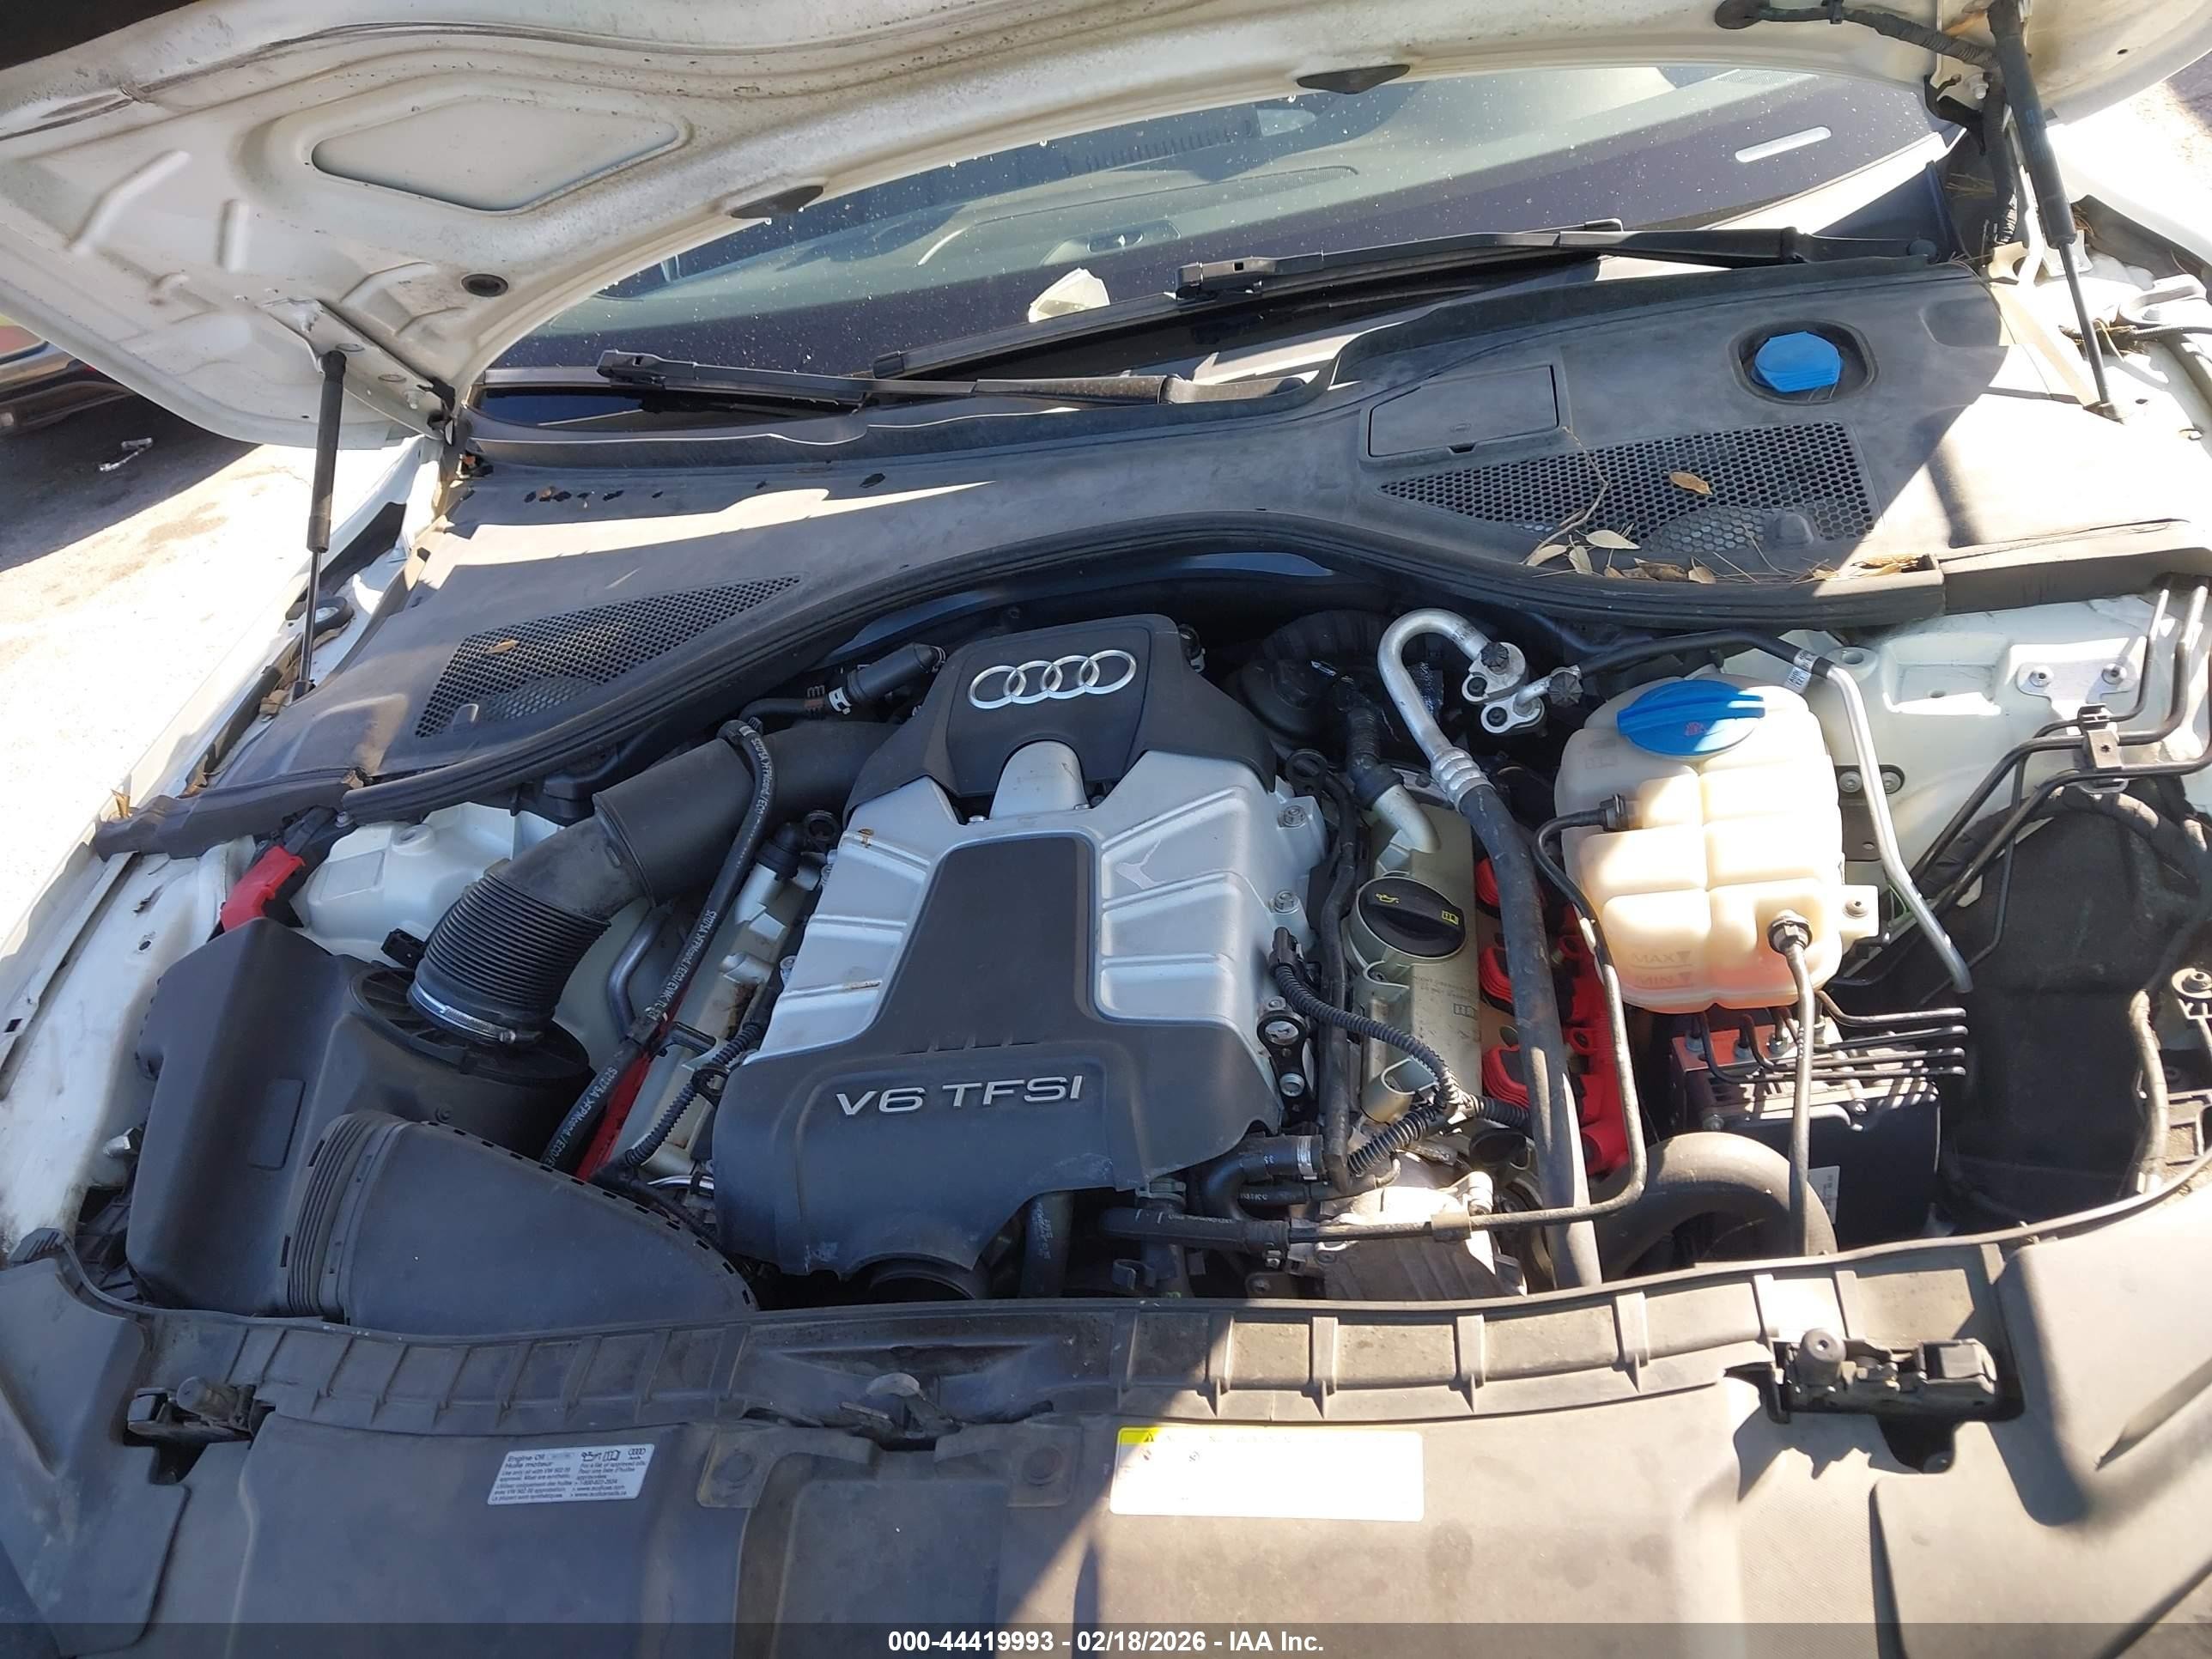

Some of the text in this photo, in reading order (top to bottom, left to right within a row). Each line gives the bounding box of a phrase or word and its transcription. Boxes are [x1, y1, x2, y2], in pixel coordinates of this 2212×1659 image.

[1633, 952, 1676, 963] MAX
[1635, 974, 1674, 985] MIN
[836, 1075, 1084, 1116] V6 TFSI
